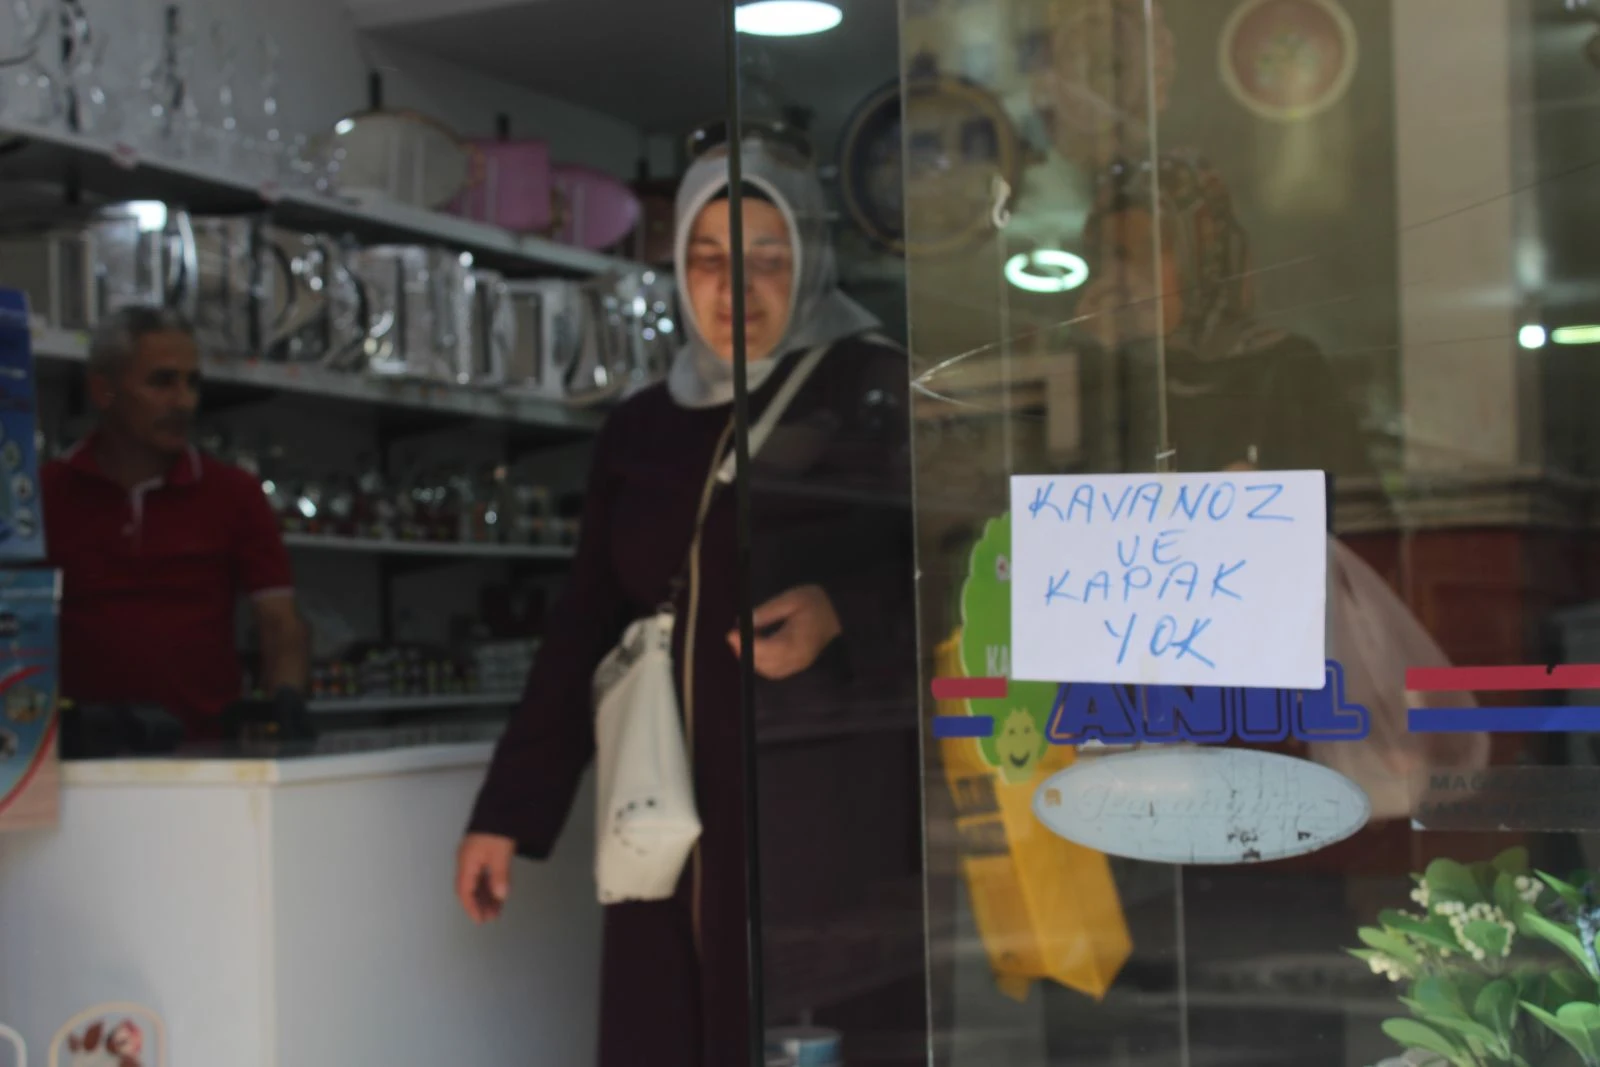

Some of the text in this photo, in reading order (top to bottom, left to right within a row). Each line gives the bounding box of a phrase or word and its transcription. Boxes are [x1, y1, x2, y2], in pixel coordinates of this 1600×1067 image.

[1028, 481, 1295, 524] KAVANOZ
[1044, 559, 1247, 607] KAPAK
[1103, 612, 1217, 670] YOK
